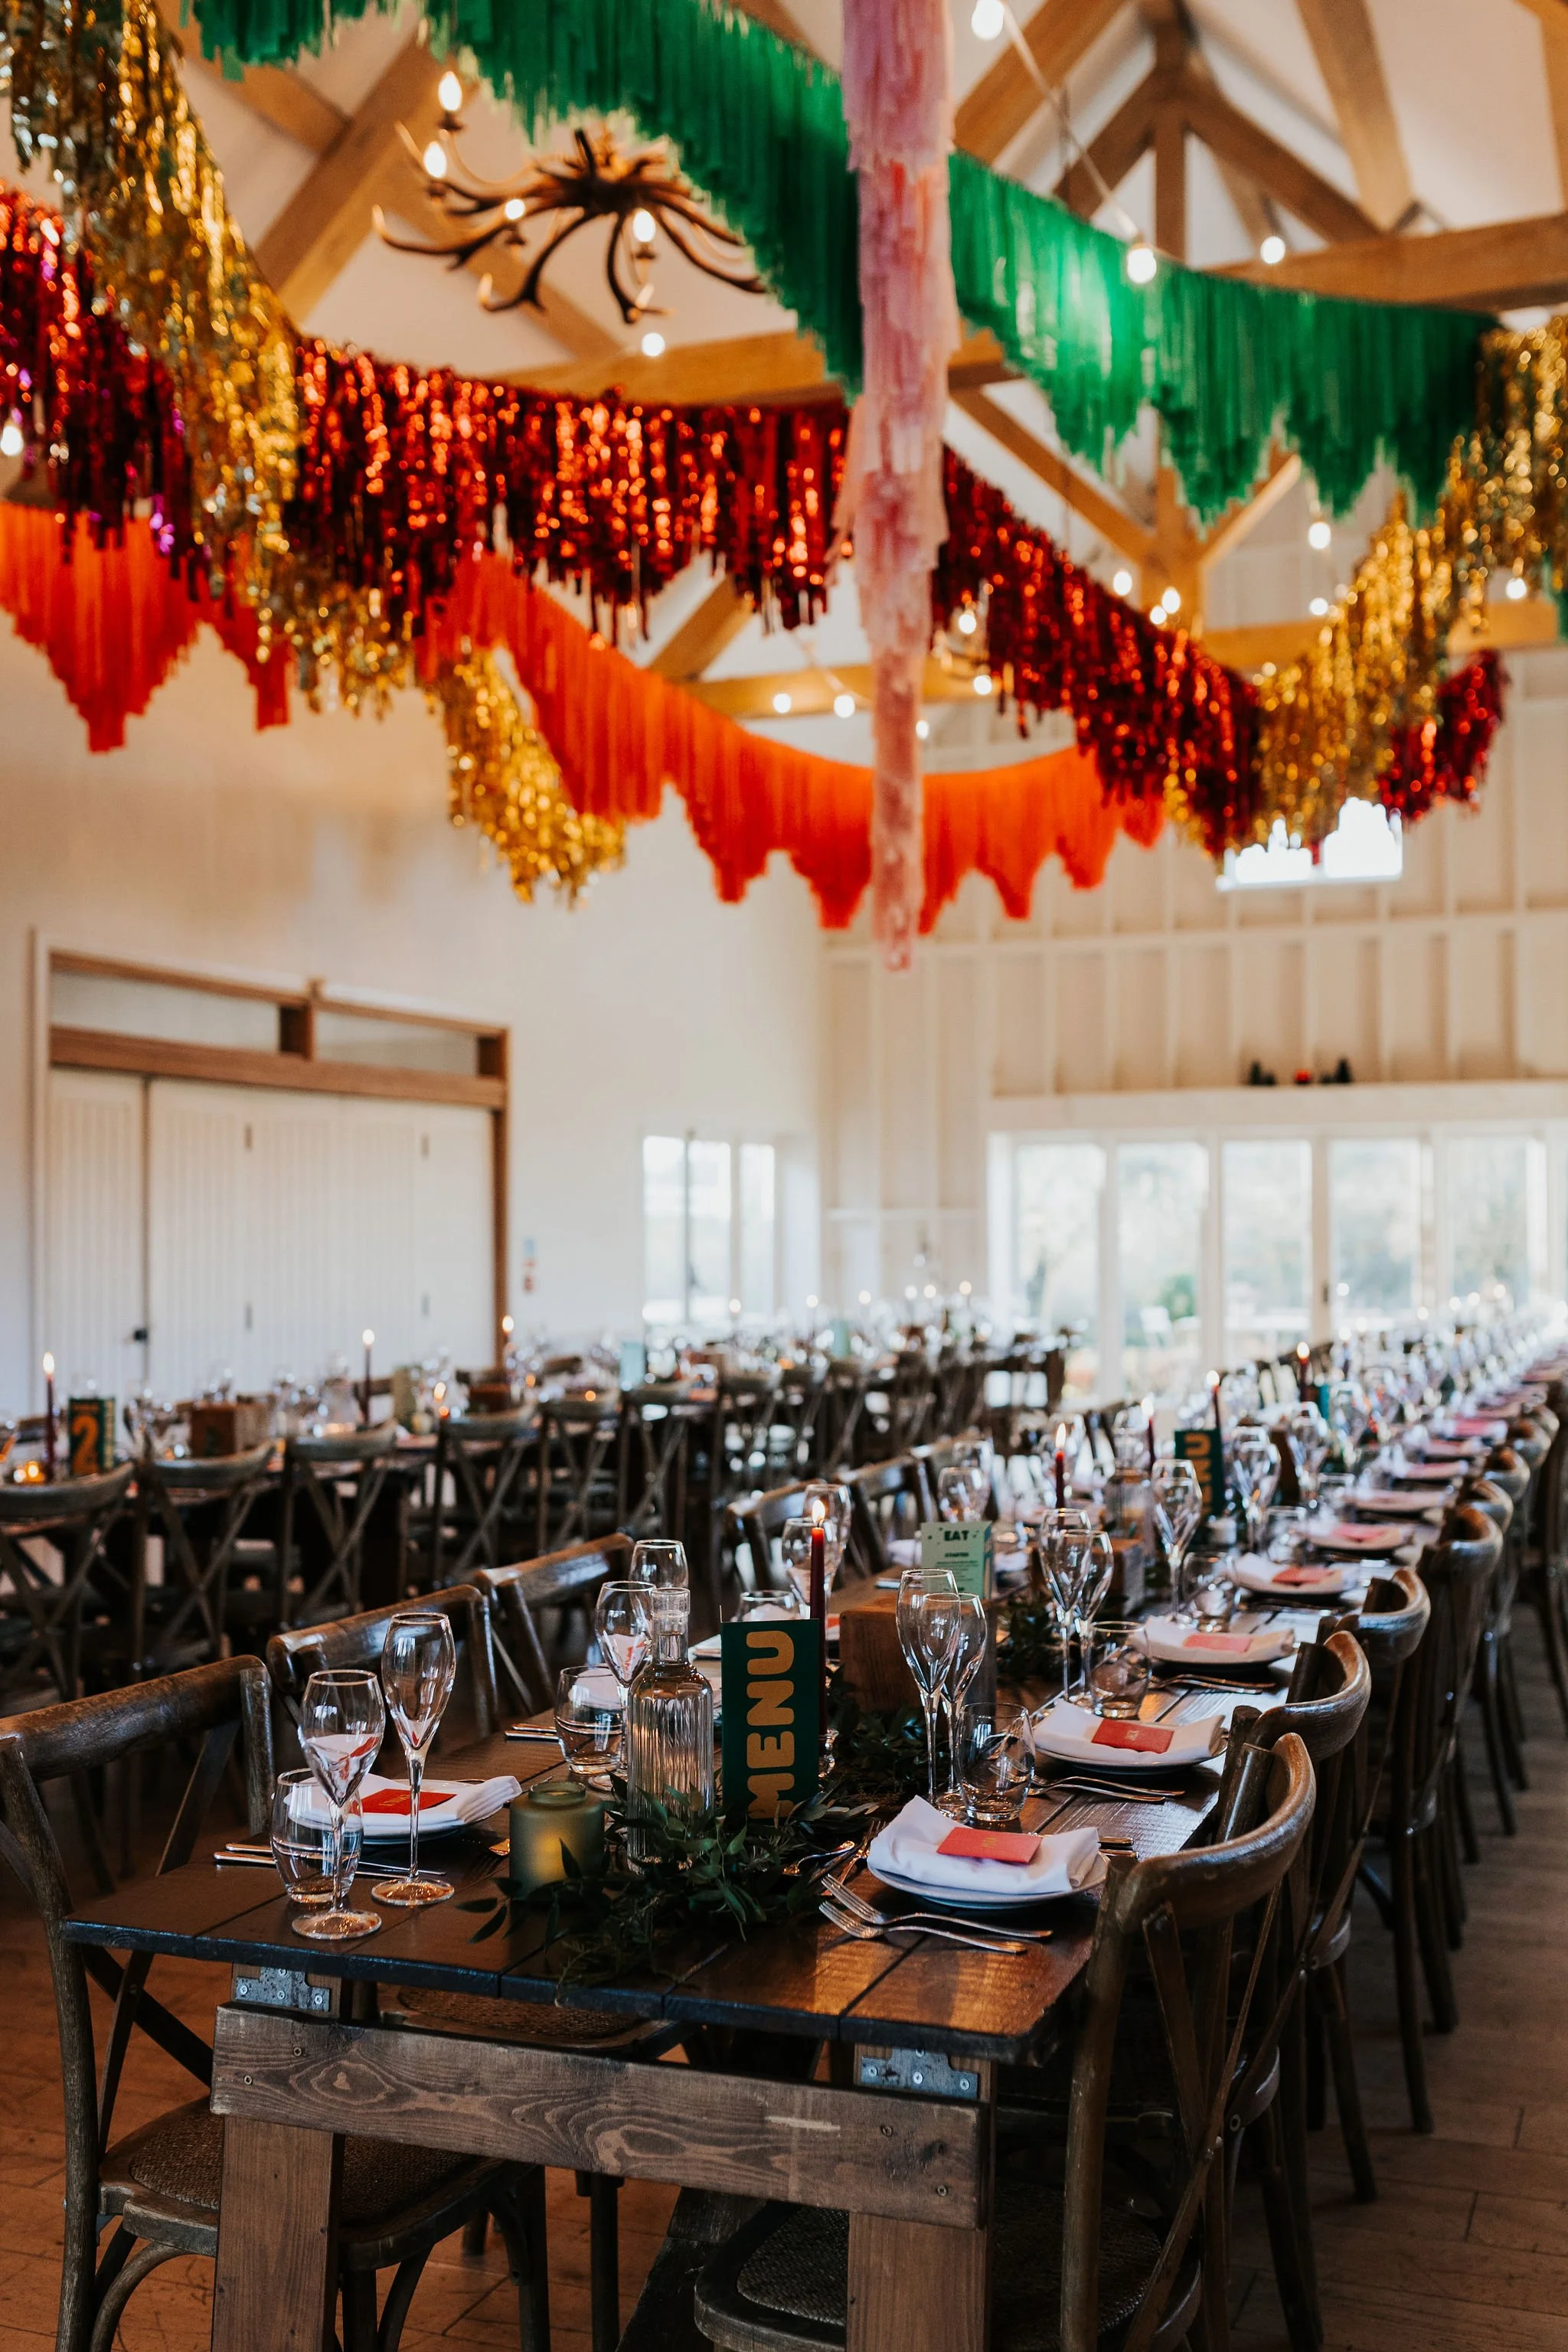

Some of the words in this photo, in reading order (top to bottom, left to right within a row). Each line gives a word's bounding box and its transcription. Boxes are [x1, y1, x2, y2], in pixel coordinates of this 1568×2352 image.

[72, 1415, 100, 1475] 2
[944, 1530, 969, 1542] EAT
[746, 1630, 795, 1819] MENU
